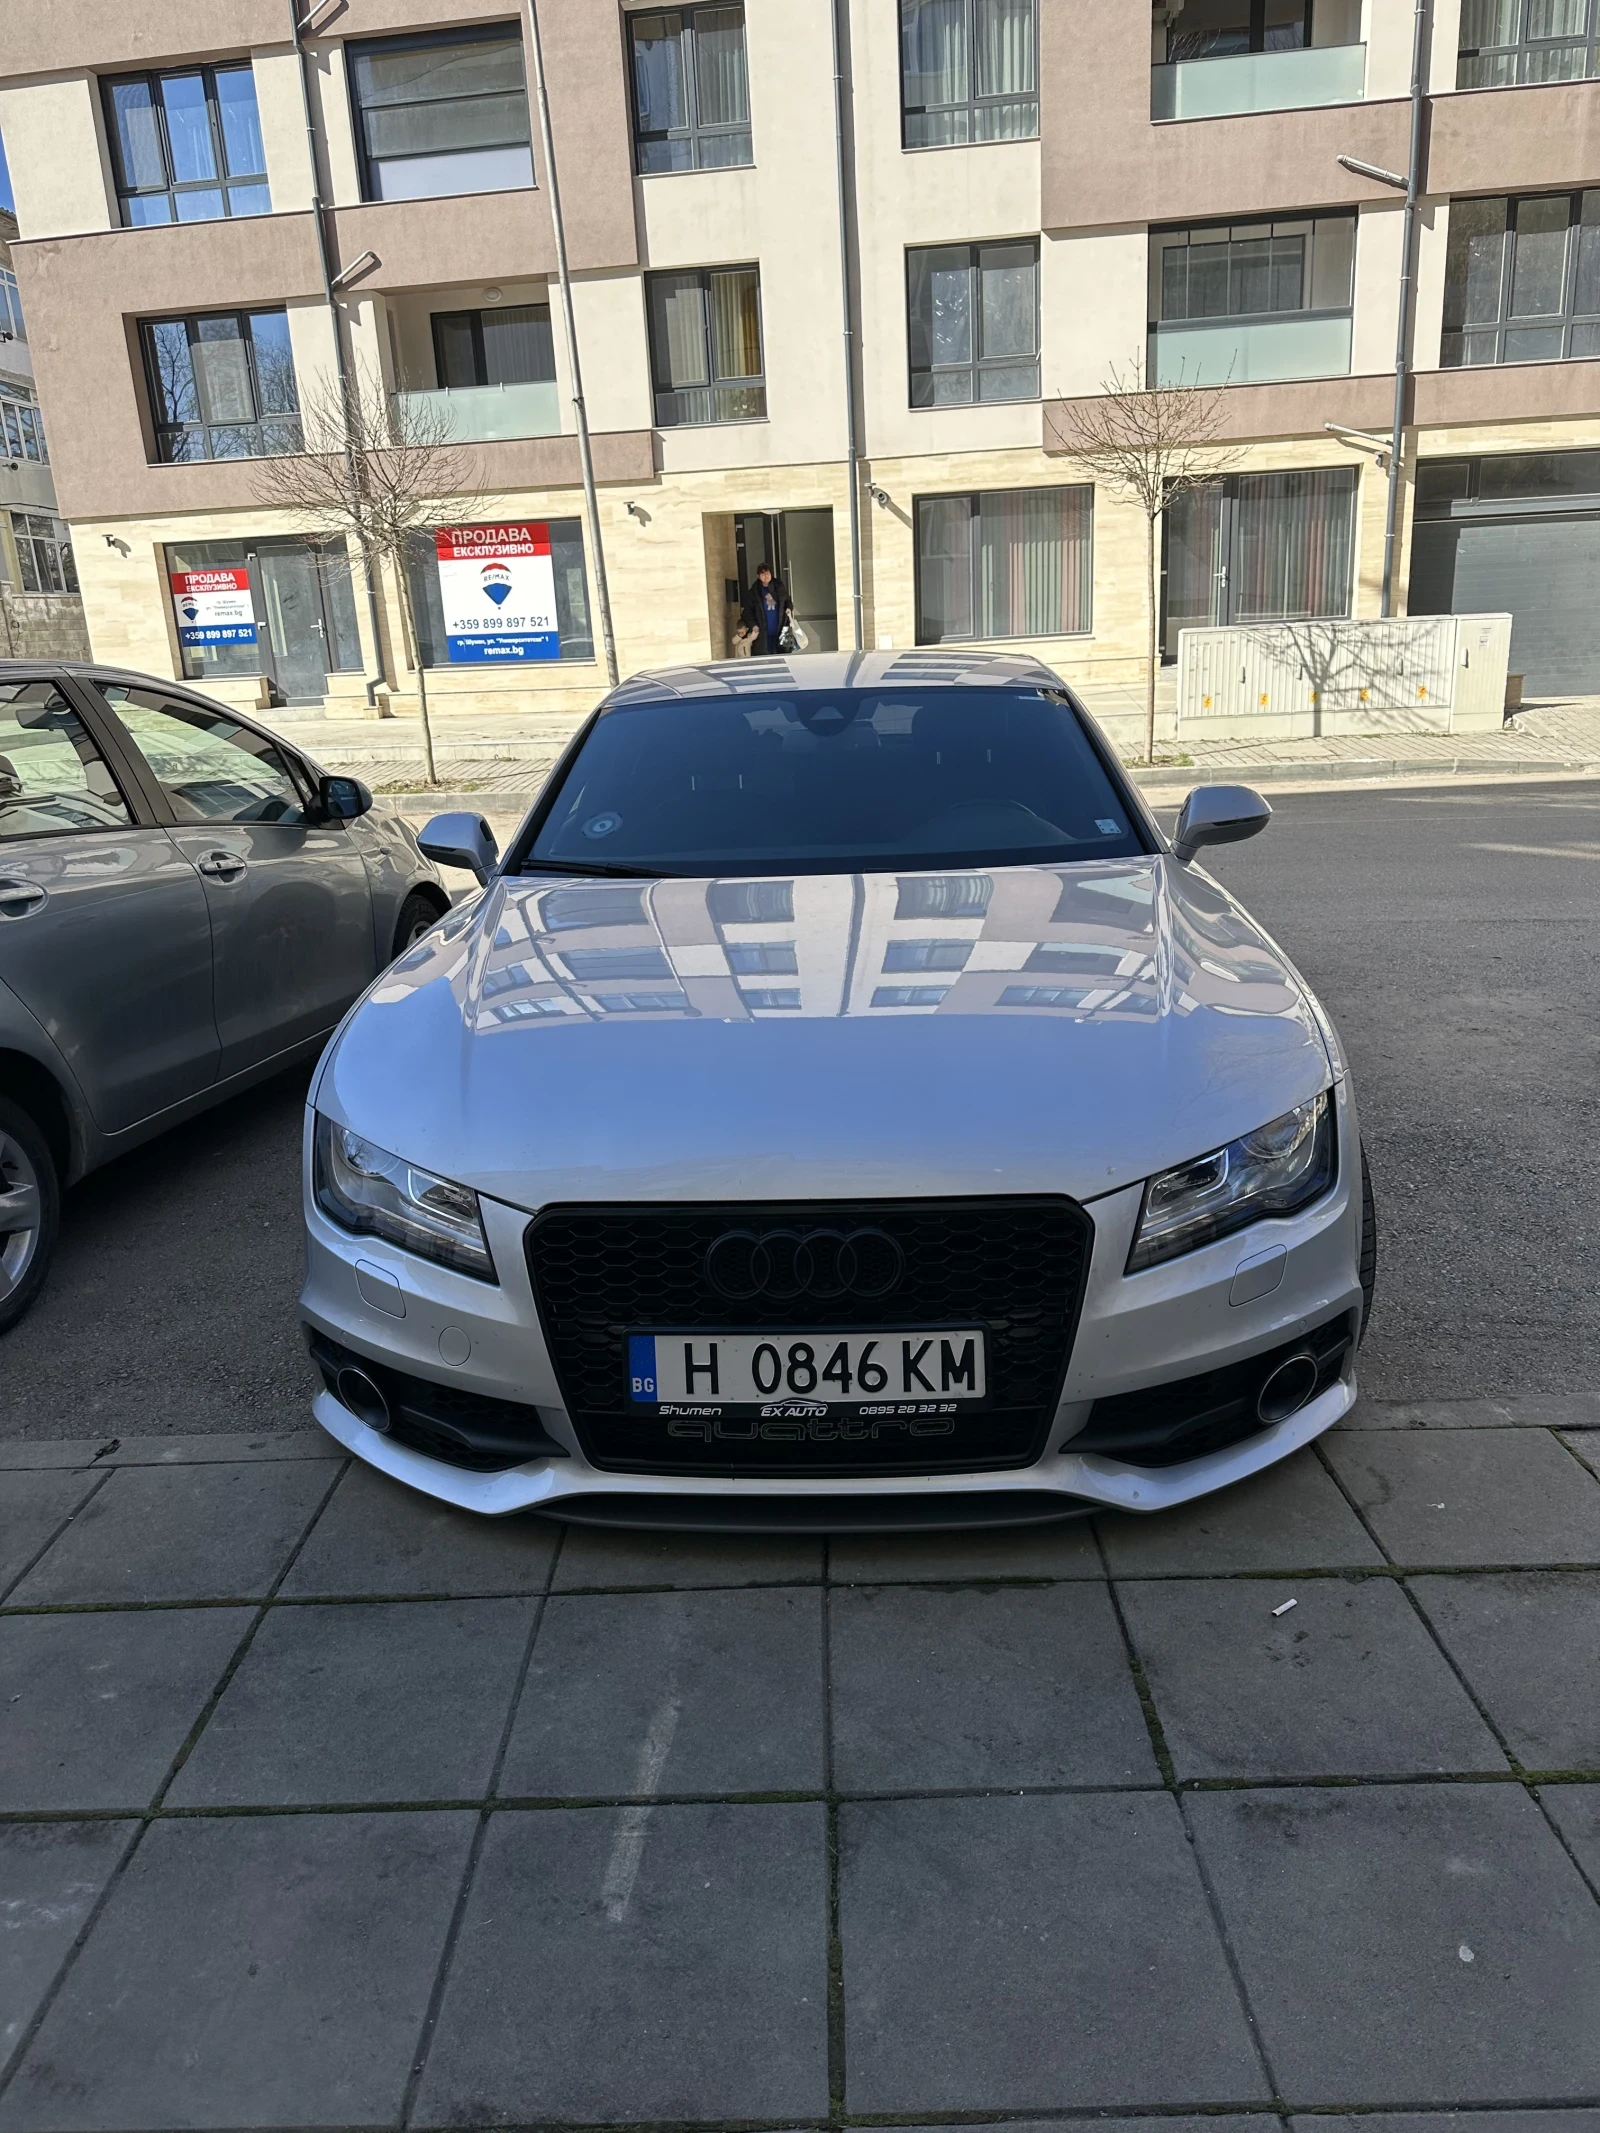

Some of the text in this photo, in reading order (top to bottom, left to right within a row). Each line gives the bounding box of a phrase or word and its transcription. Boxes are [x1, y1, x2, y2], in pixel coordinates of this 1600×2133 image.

[451, 527, 531, 544] ПРОДАВА
[453, 543, 534, 557] ЕКСКЛУЗИВНО
[185, 572, 235, 584] ПРОДАВА
[483, 573, 510, 582] RE/MAX
[186, 583, 237, 592] ЕКСКЛУЗИВНО
[215, 609, 243, 617] remax.bg
[452, 616, 549, 630] +359 899 897 521
[185, 628, 252, 640] +359 899 897 521
[484, 645, 524, 656] remax.bg
[684, 1338, 976, 1395] H 0846 KM
[632, 1377, 655, 1393] BG
[658, 1405, 722, 1416] Shumen
[761, 1407, 828, 1417] EX AUTO
[859, 1403, 957, 1415] 0895 28 32 32
[668, 1417, 955, 1442] quattro
